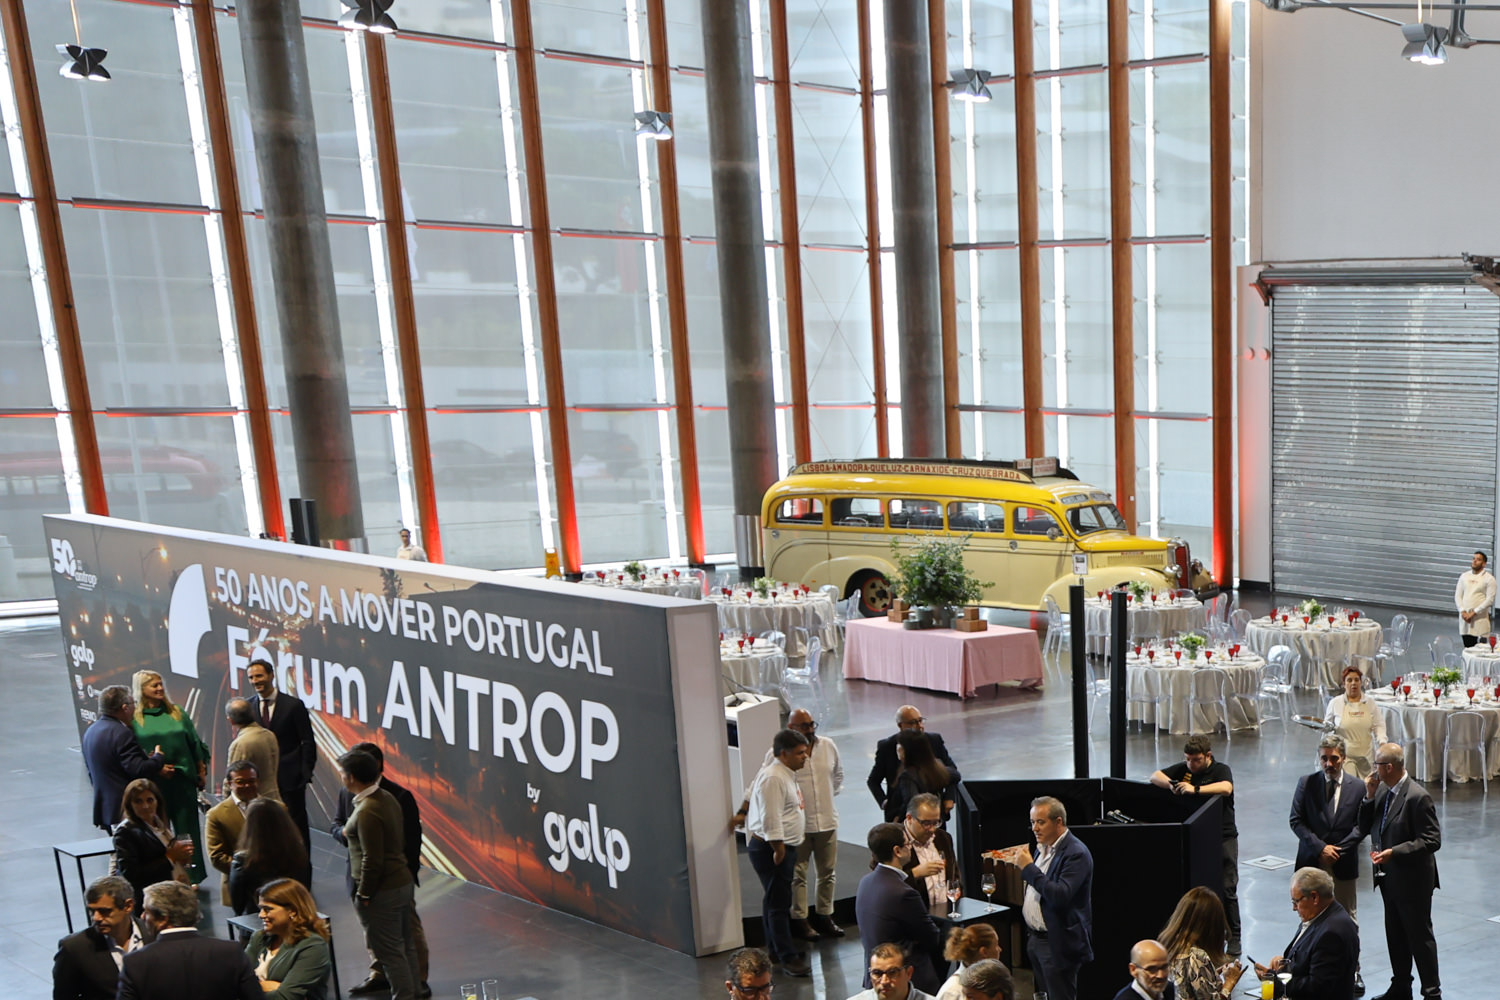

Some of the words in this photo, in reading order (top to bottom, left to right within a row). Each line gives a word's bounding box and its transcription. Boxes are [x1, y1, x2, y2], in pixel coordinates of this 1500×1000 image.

[71, 640, 95, 671] galp
[214, 567, 242, 605] 50
[248, 573, 313, 619] ANOS
[319, 585, 338, 624] A
[340, 588, 438, 643] MOVER
[442, 605, 614, 677] PORTUGAL
[381, 660, 620, 780] ANTROP
[526, 782, 541, 803] by
[543, 803, 631, 889] galp
